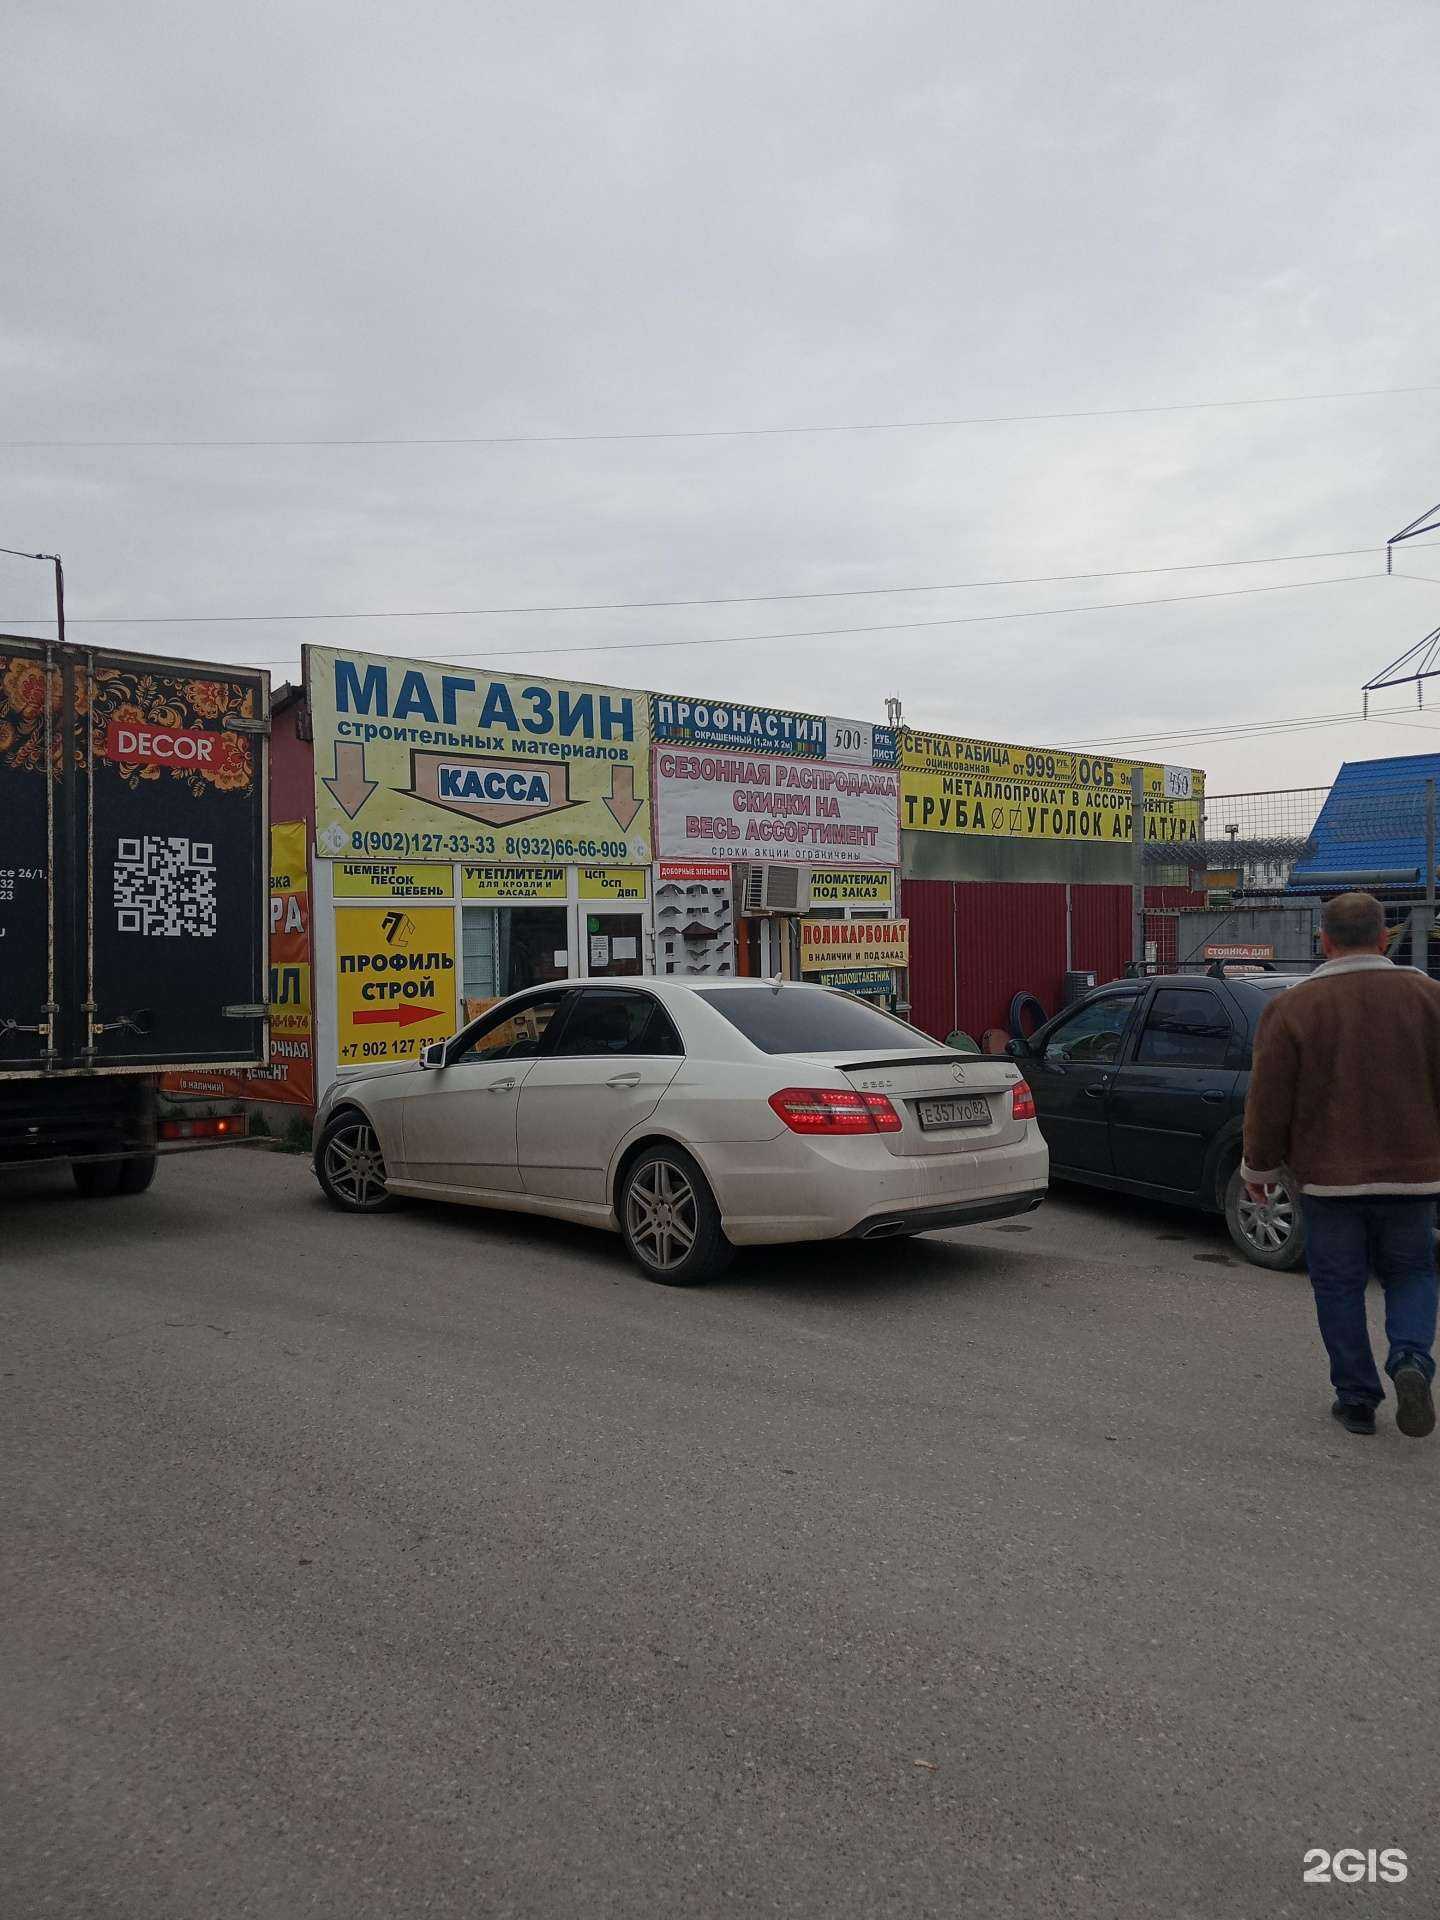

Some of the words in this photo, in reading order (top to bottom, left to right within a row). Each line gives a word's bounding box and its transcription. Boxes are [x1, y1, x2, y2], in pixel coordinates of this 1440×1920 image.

[334, 659, 634, 741] МАГАЗИН
[658, 700, 823, 742] ПРОФНАСТИЛ
[118, 730, 214, 762] DECOR
[337, 719, 504, 750] строительных
[512, 740, 629, 761] материалов
[694, 730, 752, 746] ОКРАШЕННЫЙ
[874, 733, 892, 745] РУБ.
[872, 749, 895, 761] ЛИСТ
[904, 735, 951, 757] СЕТКА
[956, 743, 1010, 767] РАБИЦА
[926, 758, 990, 774] оцинкованная
[1026, 753, 1056, 778] 999
[1079, 758, 1114, 787] ОСБ
[660, 755, 771, 786] СЕЗОННАЯ
[775, 764, 897, 797] РАСПРОДАЖА
[440, 768, 549, 802] КАССА
[943, 777, 1065, 805] МЕТАЛЛОПРОКАТ
[1072, 791, 1079, 806] В
[732, 790, 811, 818] СКИДКИ
[815, 796, 841, 818] НА
[904, 795, 986, 829] ТРУБА
[1027, 807, 1102, 836] УГОЛОК
[686, 816, 740, 840] ВЕСЬ
[745, 819, 879, 846] АССОРТИМЕНТ
[352, 831, 495, 854] 8(902)127-33-33
[506, 837, 627, 859] 8(932)66-66-909
[711, 845, 748, 858] сроки
[754, 846, 789, 858] акции
[795, 848, 861, 860] ограничены
[343, 865, 398, 876] ЦЕМЕНТ
[464, 868, 563, 880] УТЕПЛИТЕЛИ
[585, 870, 606, 879] ЦСП
[661, 867, 695, 876] ДОБОРНЫЕ
[370, 875, 415, 885] ПЕСОК
[478, 881, 499, 889] ДЛЯ
[601, 879, 622, 888] ОСП
[811, 874, 887, 885] ИЛОМАТЕРИАЛ
[391, 886, 444, 896] ЩЕБЕНЬ
[497, 889, 538, 897] ФАСАДА
[617, 889, 638, 898] ДВП
[813, 887, 838, 899] ПОД
[842, 887, 878, 898] ЗАКАЗ
[803, 925, 907, 945] ПОЛИКАРБОНАТ
[340, 951, 454, 974] ПРОФИЛЬ
[815, 952, 852, 961] НАЛИЧИИ
[880, 950, 904, 960] ЗАКАЗ
[361, 976, 435, 1000] СТРОЙ
[342, 1043, 358, 1057] +7
[363, 1041, 387, 1056] 902
[392, 1039, 415, 1053] 127
